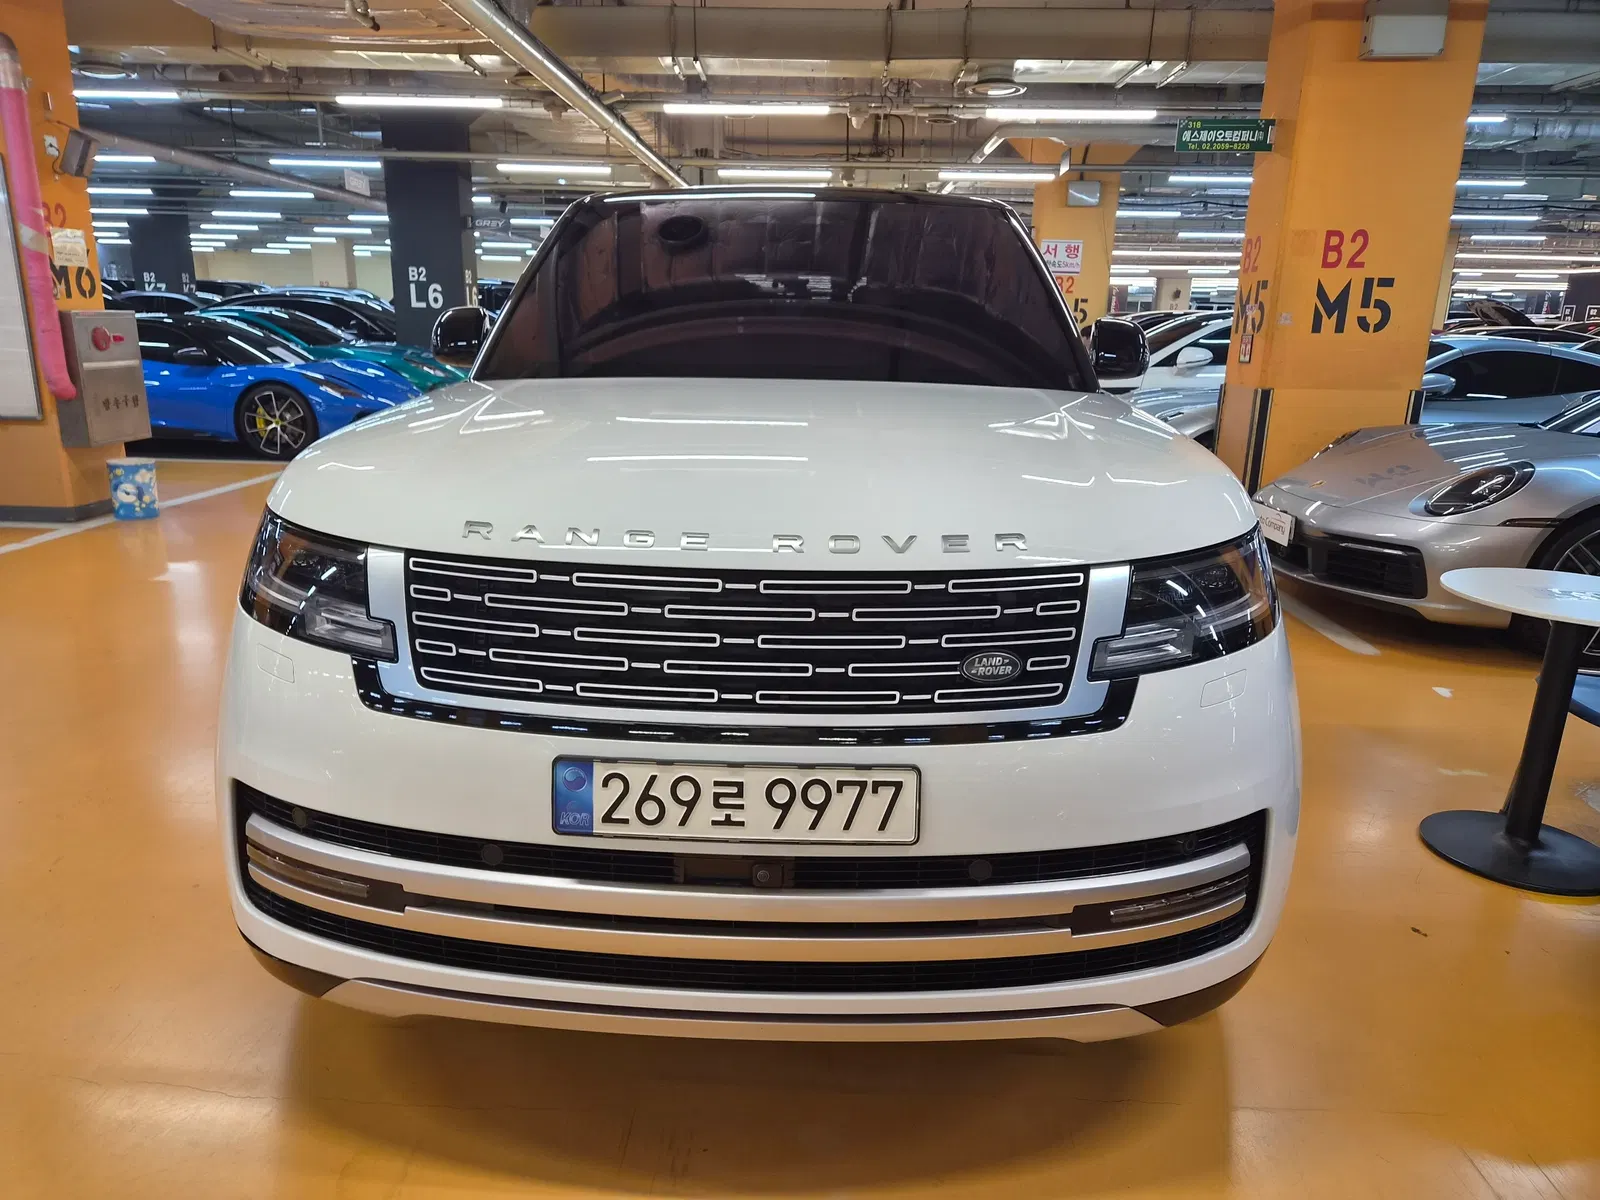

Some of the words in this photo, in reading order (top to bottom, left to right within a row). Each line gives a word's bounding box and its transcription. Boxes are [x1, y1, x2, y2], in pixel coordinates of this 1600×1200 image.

[1188, 121, 1201, 129] 318
[475, 219, 505, 228] GREY
[1243, 236, 1261, 274] B2
[1321, 229, 1370, 269] B2
[143, 272, 156, 282] B2
[408, 266, 427, 281] B2
[410, 283, 444, 309] L6
[1235, 280, 1268, 334] M5
[1311, 277, 1395, 334] M5
[1073, 298, 1089, 324] 5
[462, 520, 710, 551] RANGE
[772, 533, 1028, 554] ROVER
[974, 656, 1003, 667] LAND
[977, 665, 1013, 676] ROVER
[601, 772, 746, 828] 269로
[765, 778, 904, 832] 9977
[559, 811, 590, 827] KOR
